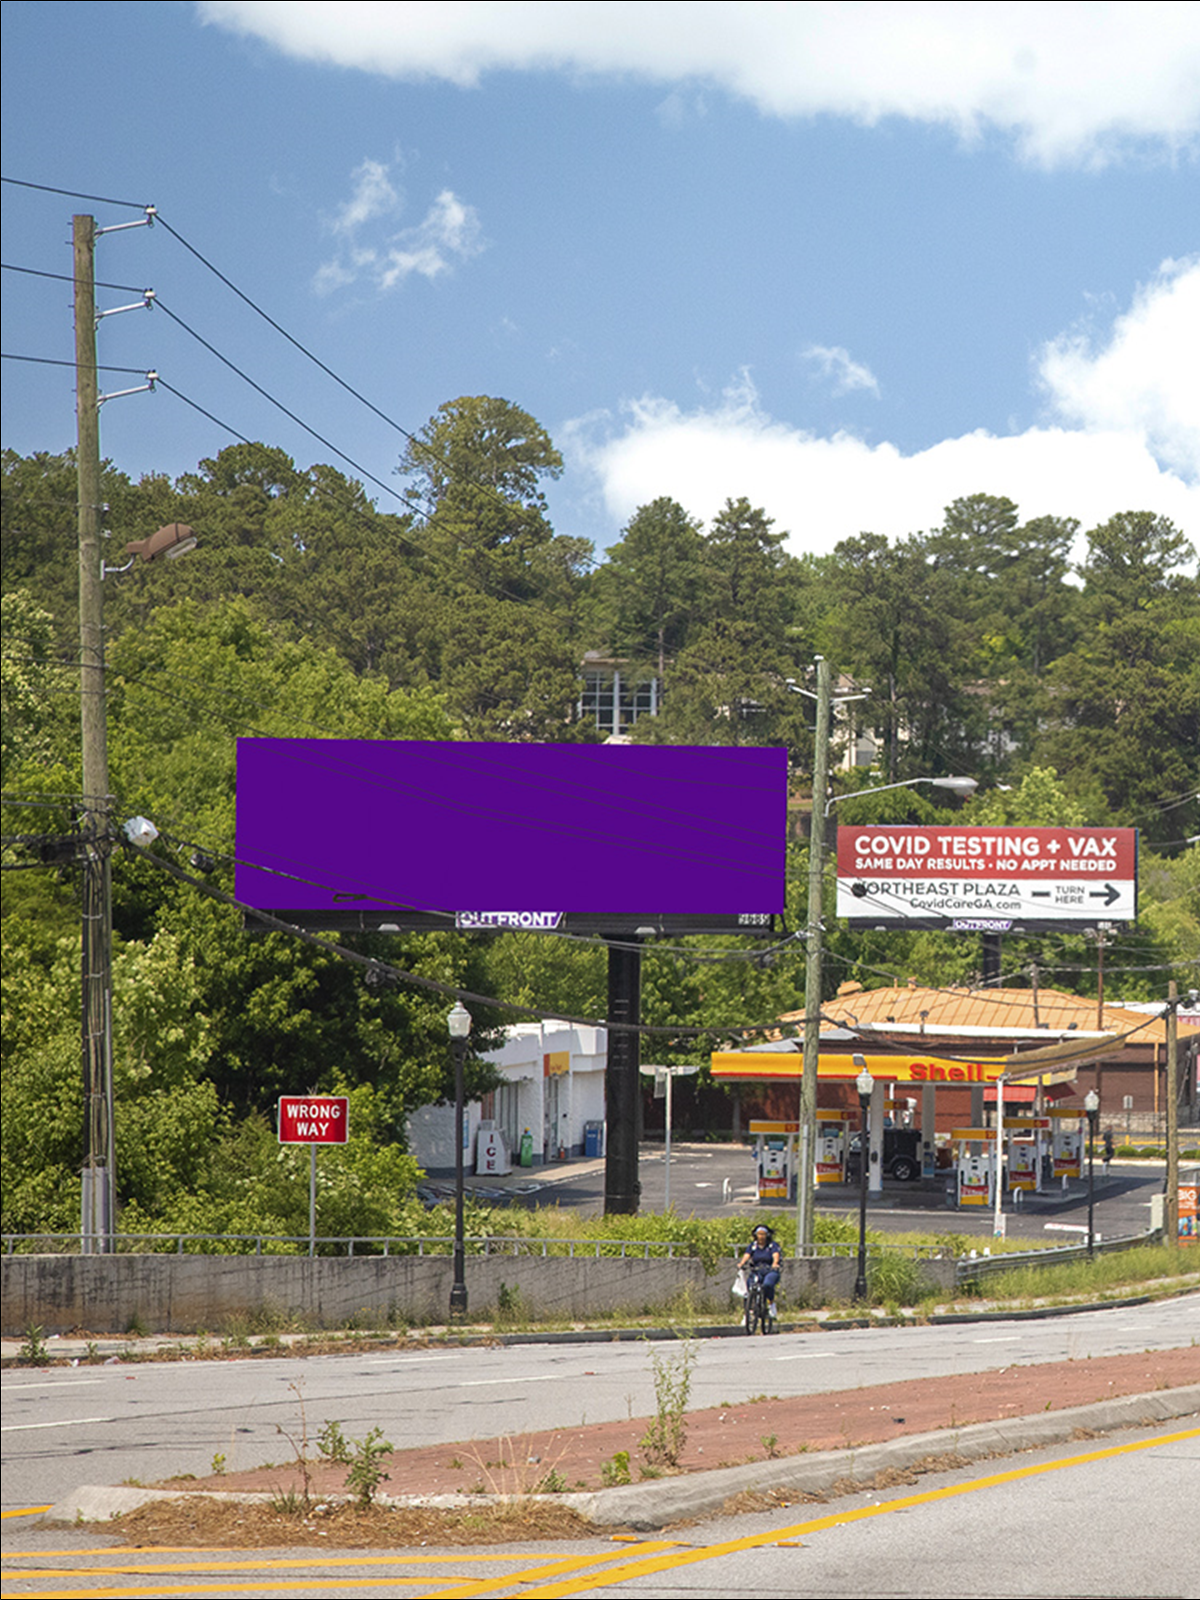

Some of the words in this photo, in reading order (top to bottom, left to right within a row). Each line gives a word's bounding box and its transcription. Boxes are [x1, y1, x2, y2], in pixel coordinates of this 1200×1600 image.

[855, 836, 930, 854] COVID
[937, 836, 1040, 856] TESTING
[1067, 837, 1117, 857] VAX
[855, 857, 893, 870] SAME
[896, 858, 924, 870] DAY
[927, 858, 986, 870] RESULTS
[996, 859, 1018, 871] NO
[1020, 859, 1057, 871] APPT
[1060, 859, 1117, 871] NEEDED
[852, 882, 960, 897] ORTHEAST
[963, 883, 1021, 896] PLAZA
[1055, 886, 1085, 894] TURN
[910, 898, 1021, 909] CovidCareGA.com
[1055, 895, 1084, 904] HERE
[910, 1063, 983, 1080] Shell
[287, 1104, 340, 1119] WRONG
[297, 1122, 329, 1136] WAY
[486, 1134, 497, 1171] ICE
